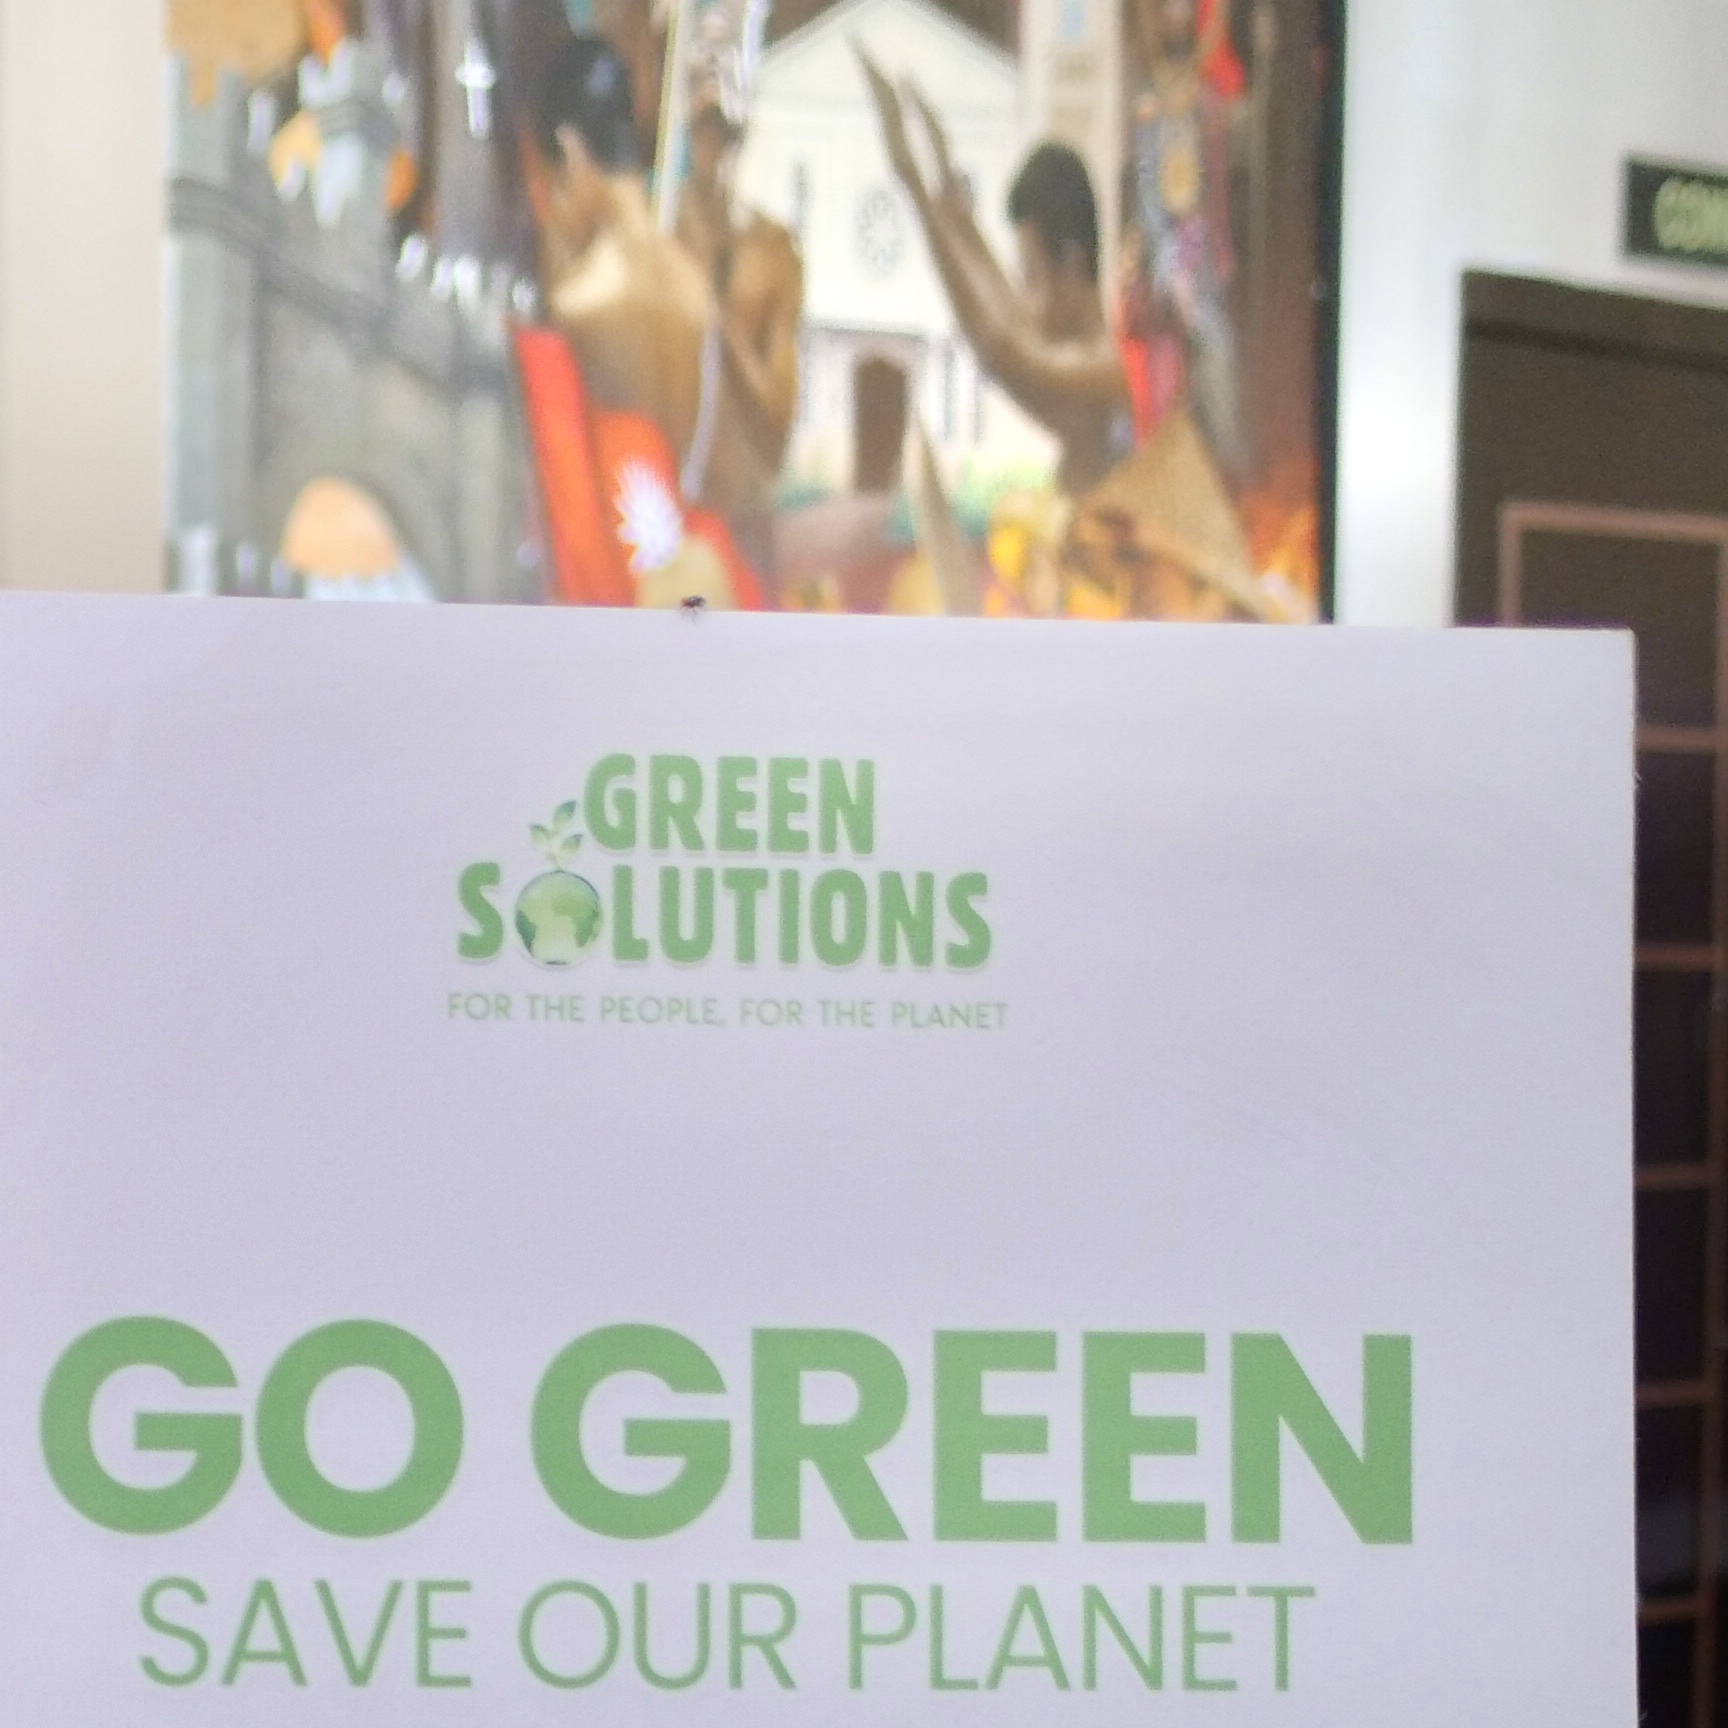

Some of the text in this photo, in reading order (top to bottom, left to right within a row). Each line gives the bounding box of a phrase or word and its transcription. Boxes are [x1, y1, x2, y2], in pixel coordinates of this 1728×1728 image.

[584, 753, 876, 855] GREEN
[446, 992, 1010, 1031] FOR THE PEOPLE, FOR THE PLANET
[38, 1315, 1414, 1546] GO GREEN
[137, 1575, 1317, 1693] SAVE OUR PLANET
